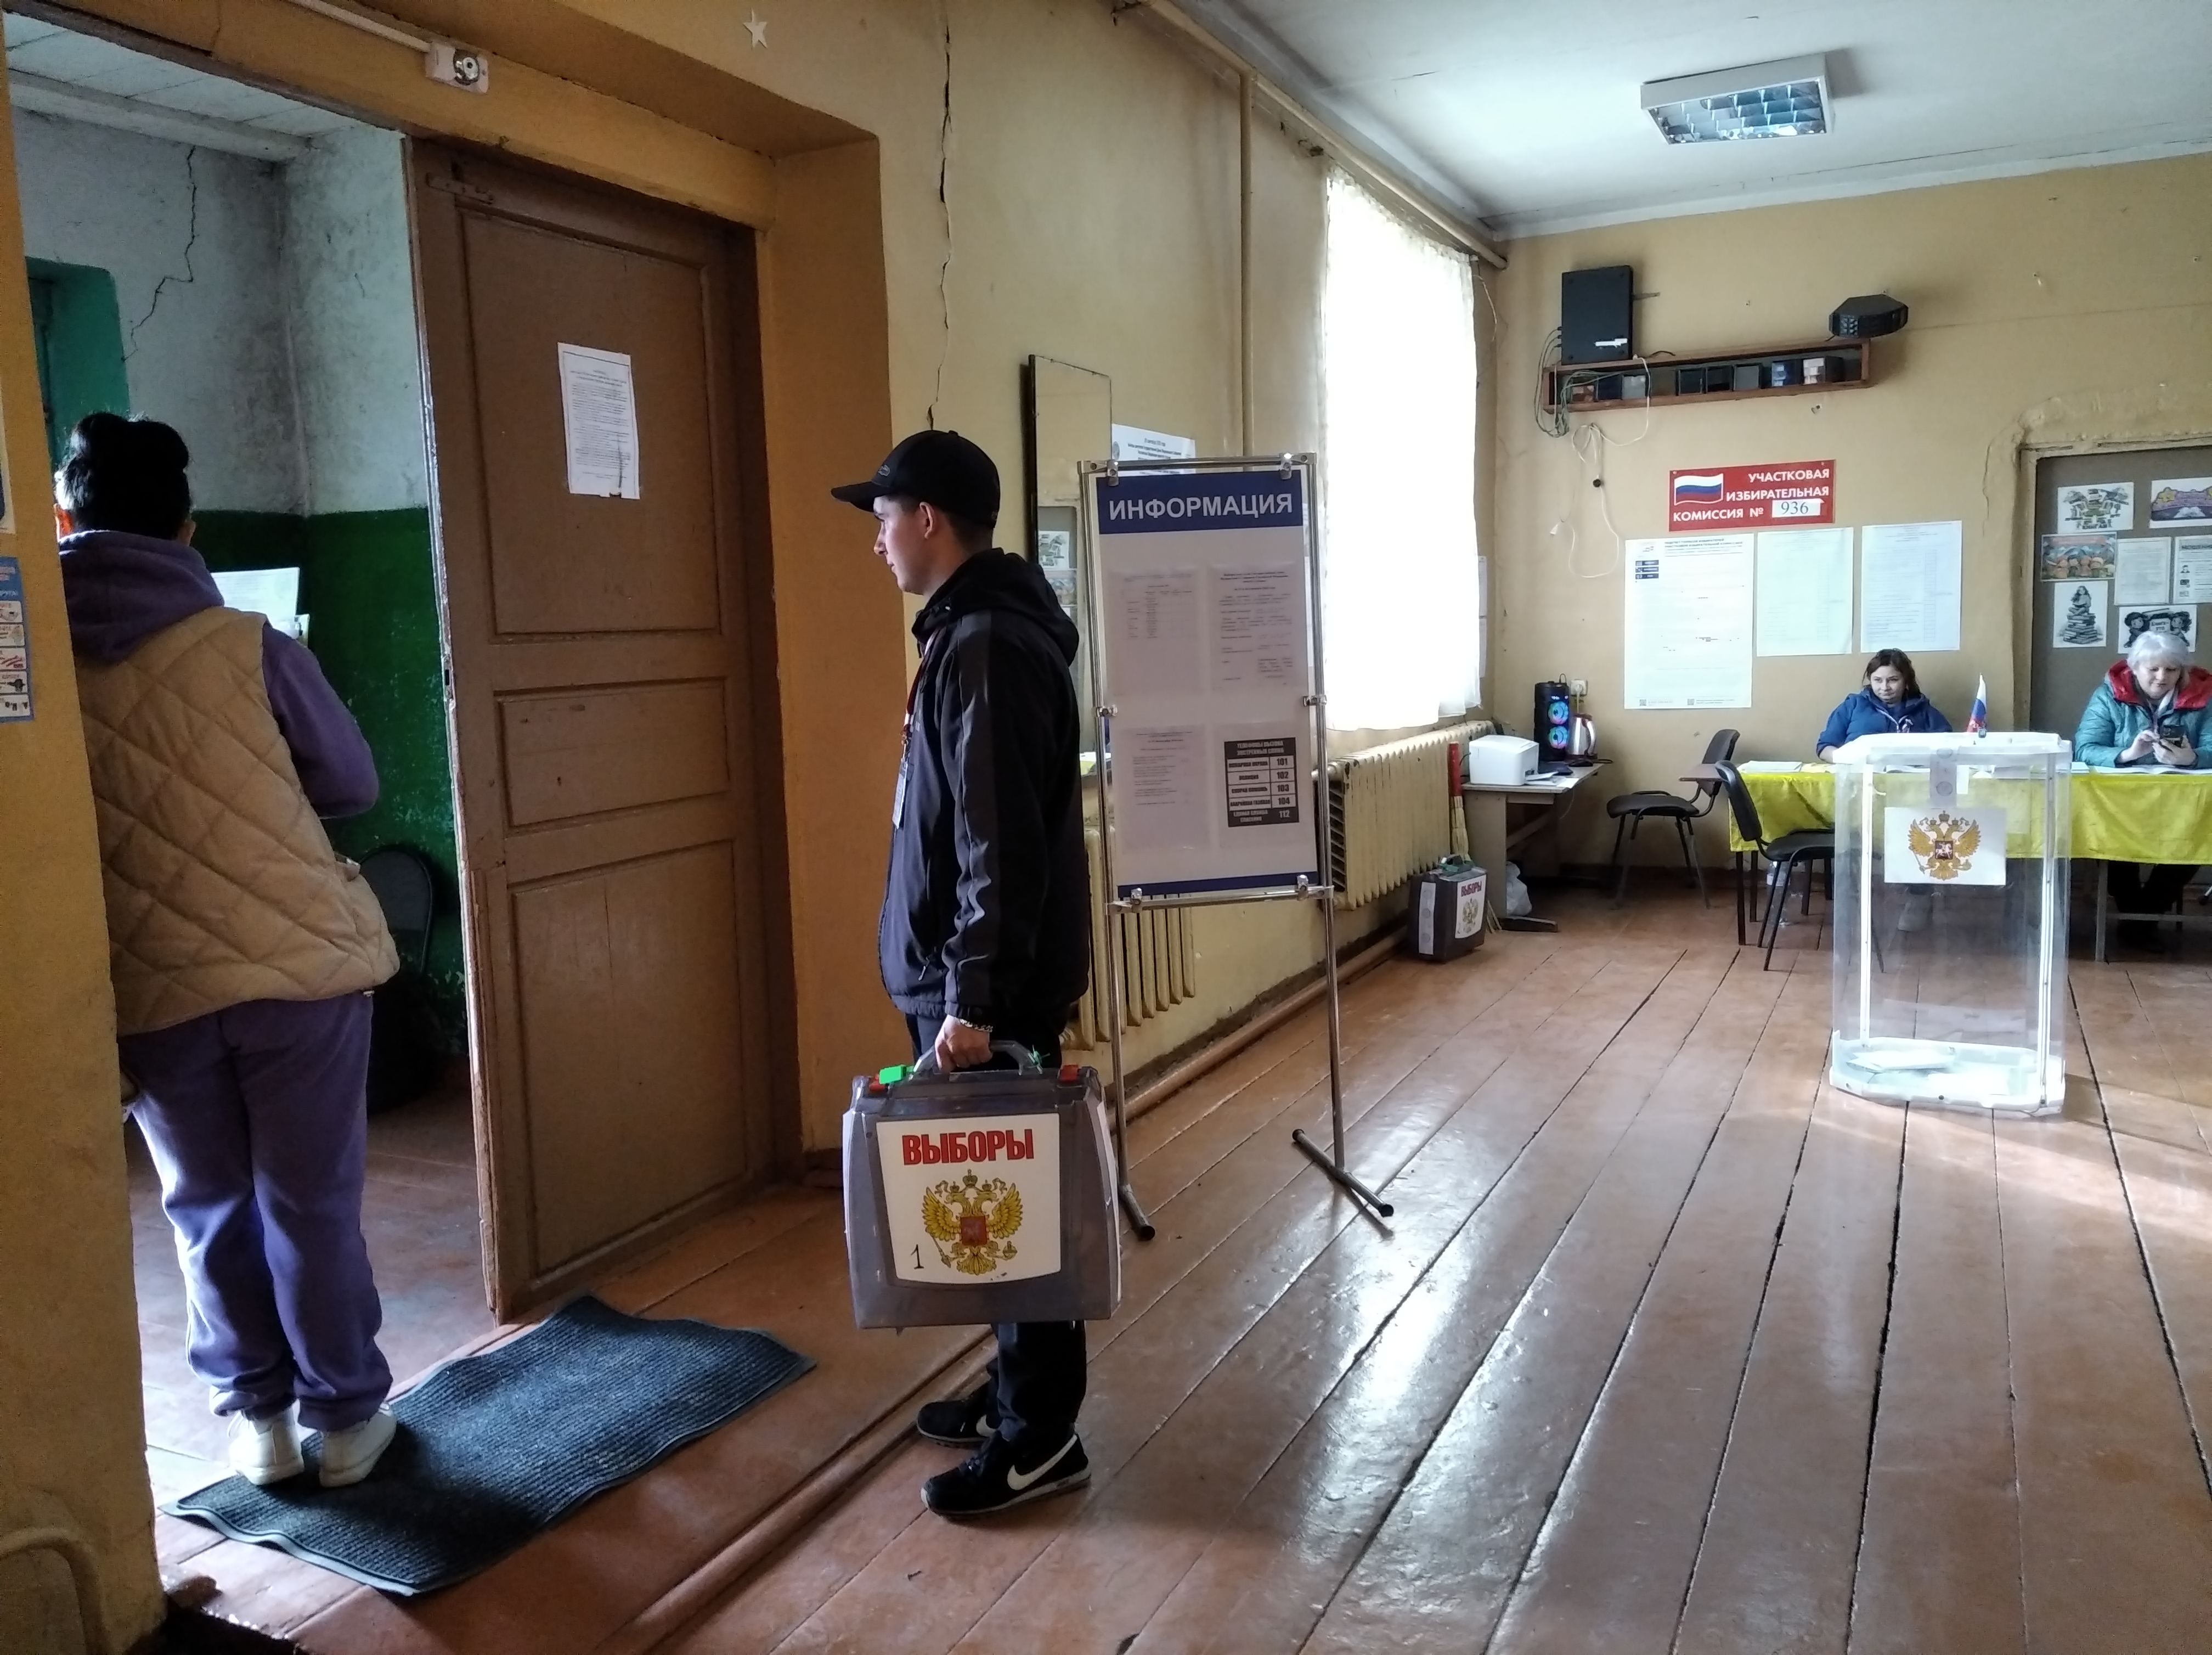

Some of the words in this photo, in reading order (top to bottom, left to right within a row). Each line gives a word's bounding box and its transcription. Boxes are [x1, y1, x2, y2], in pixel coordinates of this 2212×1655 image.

[1748, 468, 1830, 483] УЧАСТКОВАЯ
[1726, 486, 1829, 502] ИЗБИРАТЕЛЬНАЯ
[1109, 493, 1293, 520] ИНФОРМАЦИЯ
[1673, 508, 1743, 522] КОМИССИЯ
[1750, 508, 1764, 517] №
[1781, 501, 1809, 516] 936
[1279, 810, 1290, 818] 112
[1461, 881, 1482, 897] ВЫБОРЫ
[902, 1129, 1034, 1166] ВЫБОРЫ
[911, 1244, 924, 1269] 1
